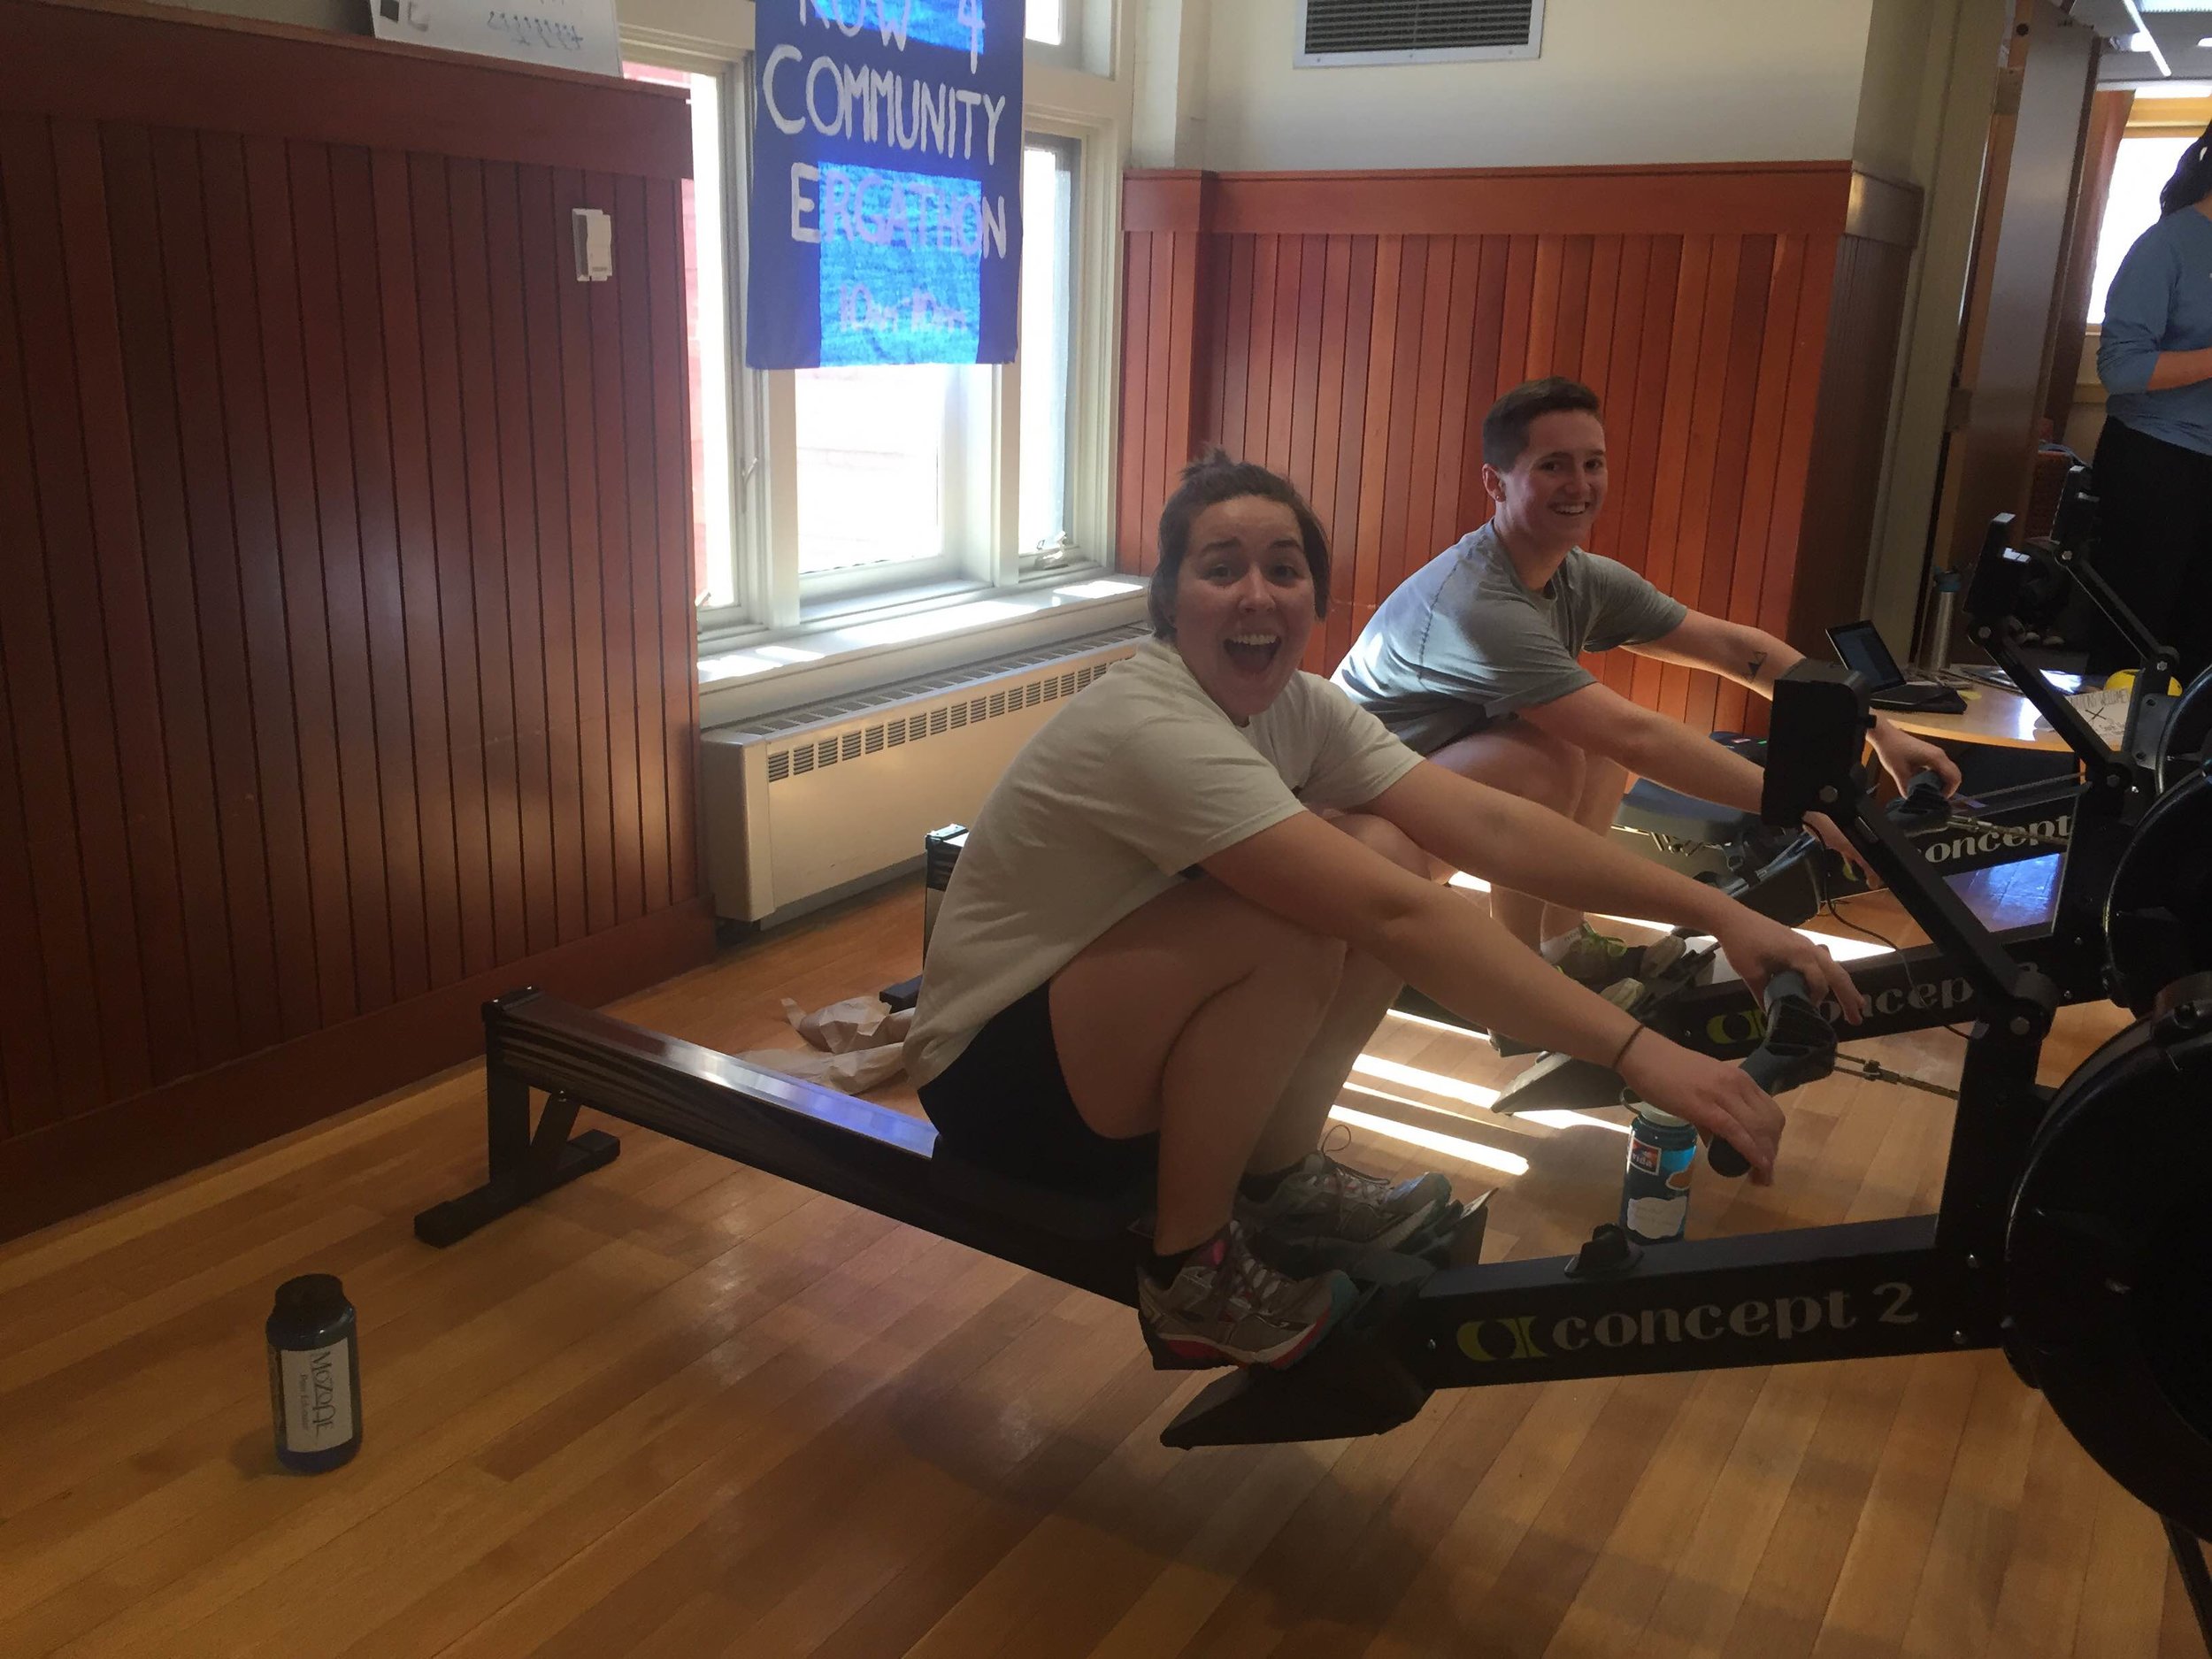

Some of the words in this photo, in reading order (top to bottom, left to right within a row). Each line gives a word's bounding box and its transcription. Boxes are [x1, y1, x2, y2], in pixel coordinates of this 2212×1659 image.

[957, 0, 986, 74] 4
[763, 43, 1006, 165] COMMUNITY
[790, 161, 1007, 259] ERGATHON
[1917, 813, 2071, 864] oncept
[1552, 1291, 1857, 1351] concept
[1875, 1281, 1919, 1325] 2
